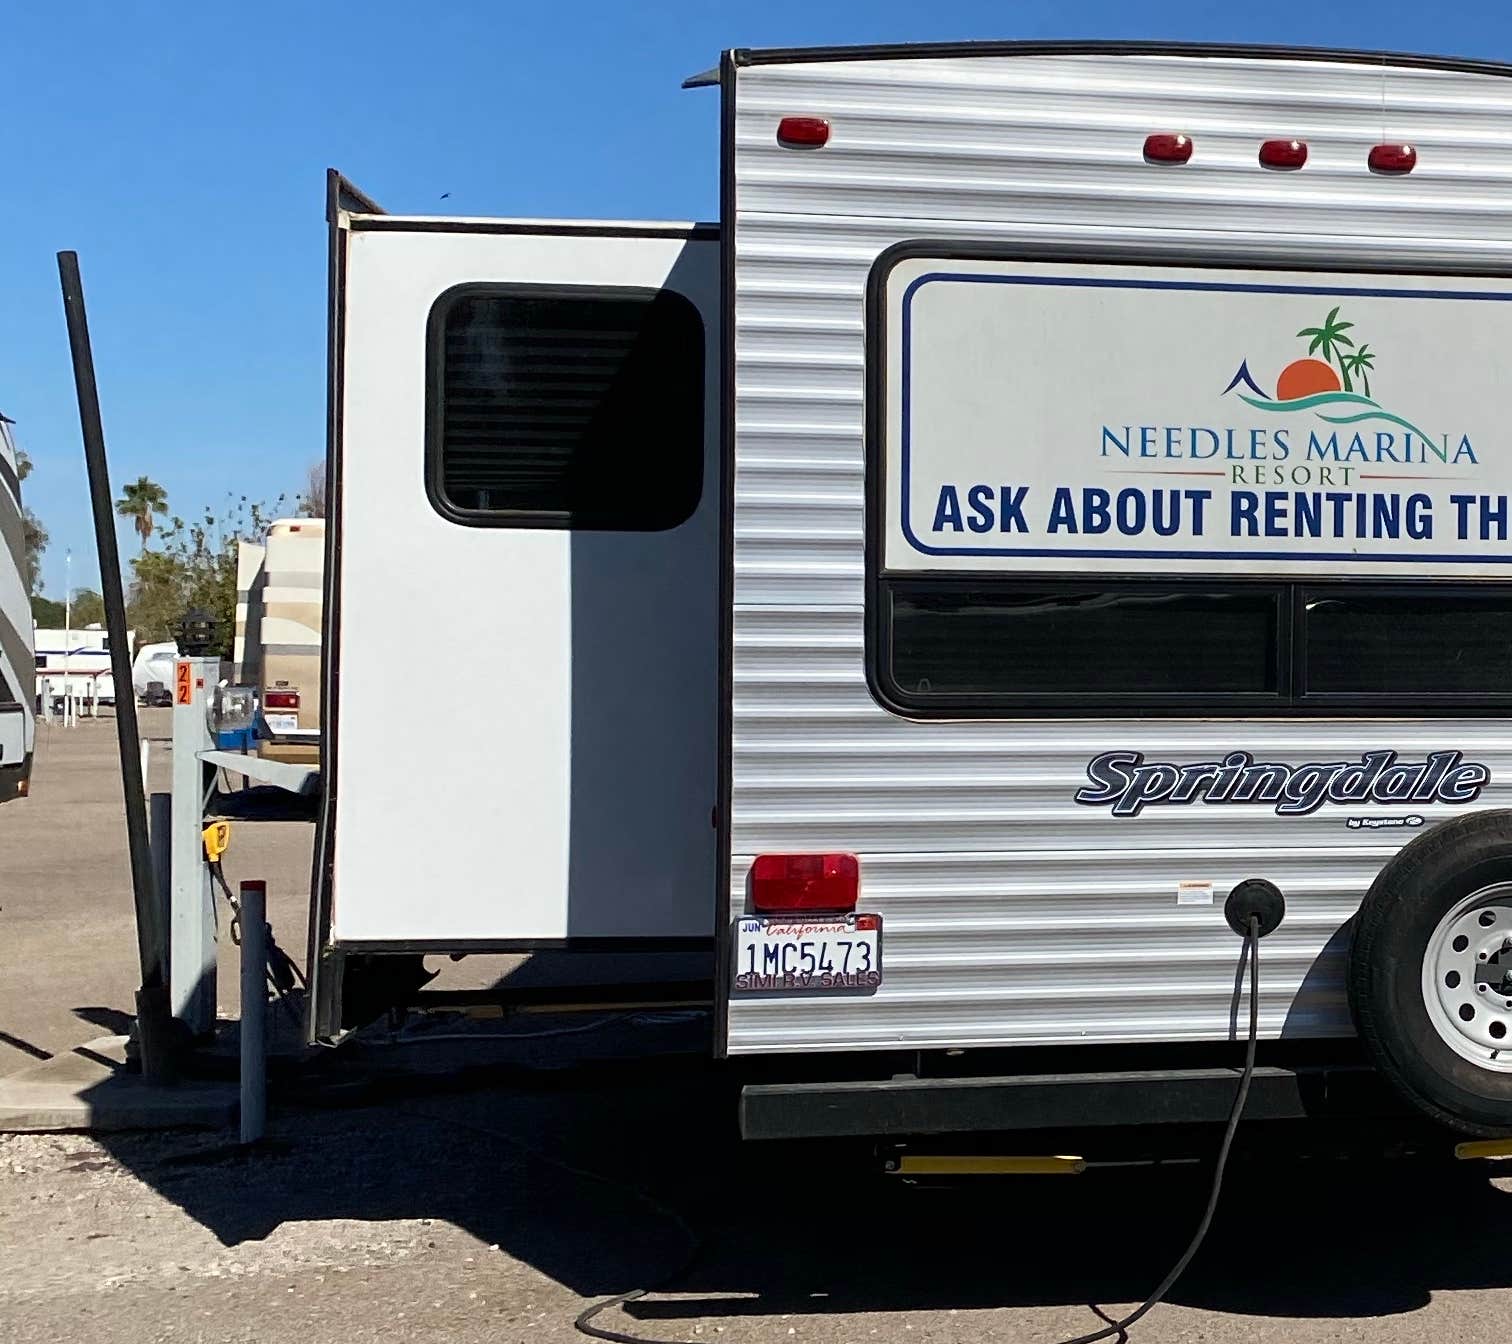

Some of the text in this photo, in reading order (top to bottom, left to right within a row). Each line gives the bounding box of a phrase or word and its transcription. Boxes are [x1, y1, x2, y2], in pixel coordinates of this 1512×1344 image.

[1100, 424, 1480, 465] NEEDLES MARINA
[1230, 464, 1356, 487] RESORT
[932, 484, 1031, 534] ASK
[1046, 486, 1213, 537] ABOUT
[1229, 490, 1434, 541] RENTING
[1075, 750, 1491, 817] Springdale
[742, 922, 761, 933] JUN
[766, 923, 852, 940] California
[746, 940, 871, 975] 1MC5473
[820, 970, 881, 987] SALES
